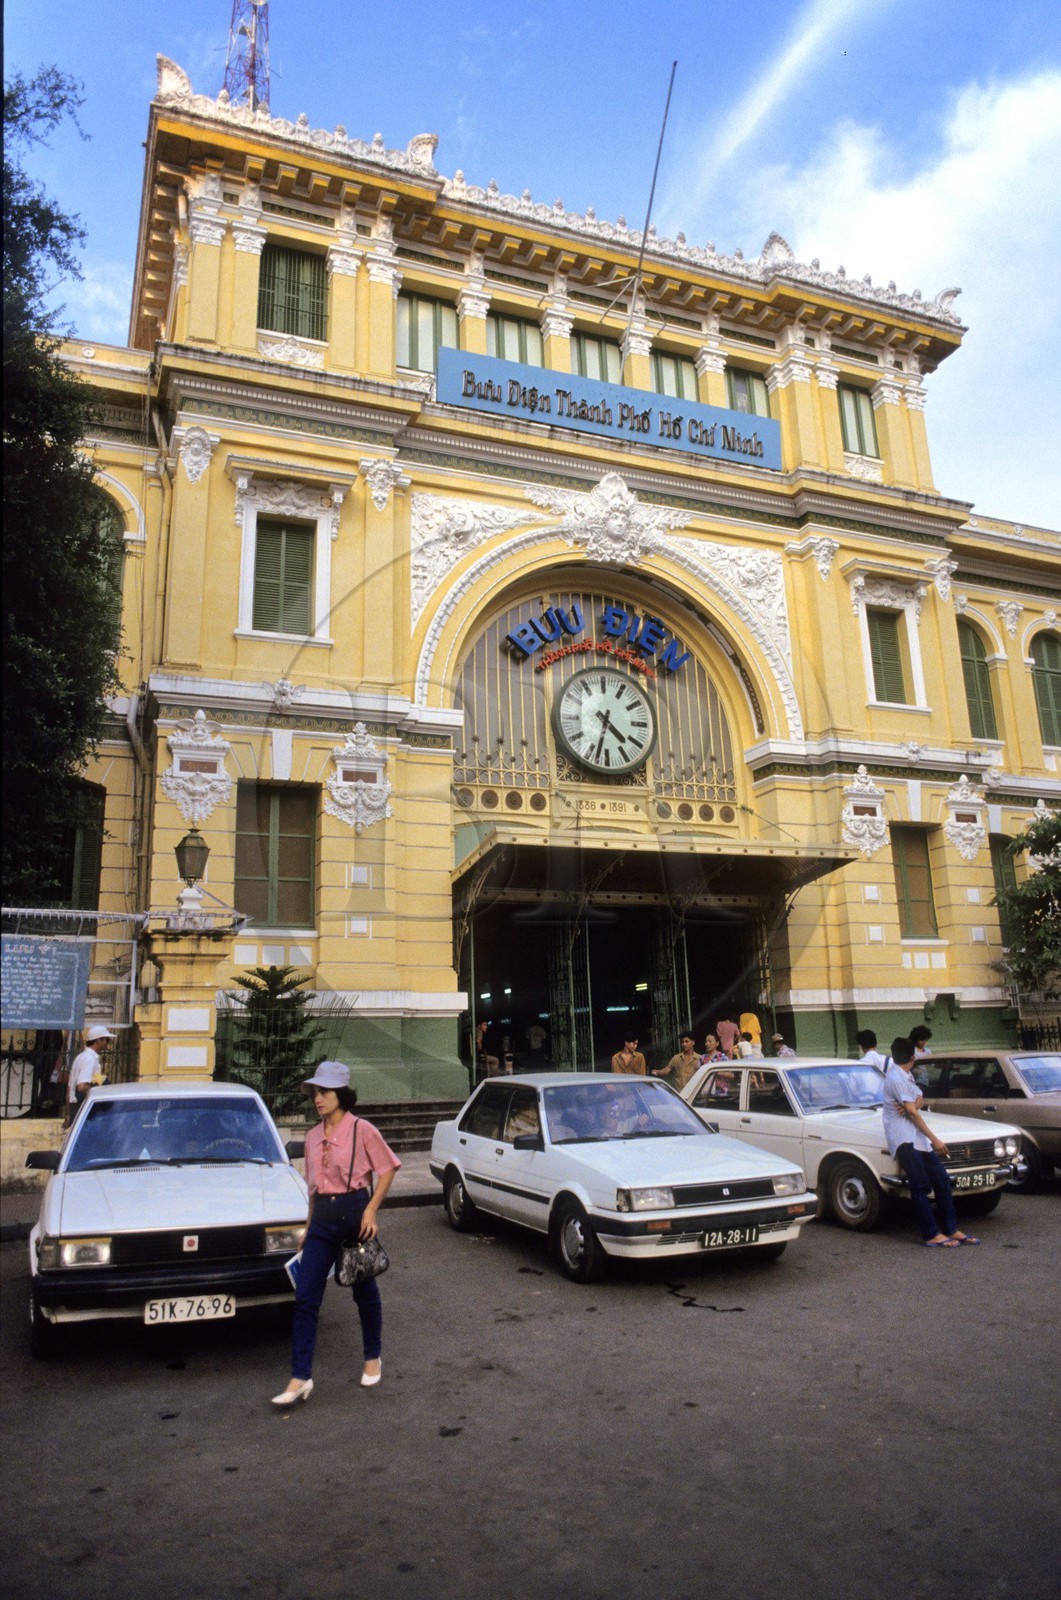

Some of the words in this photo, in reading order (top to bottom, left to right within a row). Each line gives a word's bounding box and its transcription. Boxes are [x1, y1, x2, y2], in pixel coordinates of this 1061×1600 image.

[555, 388, 612, 425] Thành
[617, 402, 652, 433] Phố
[688, 418, 717, 447] Chí
